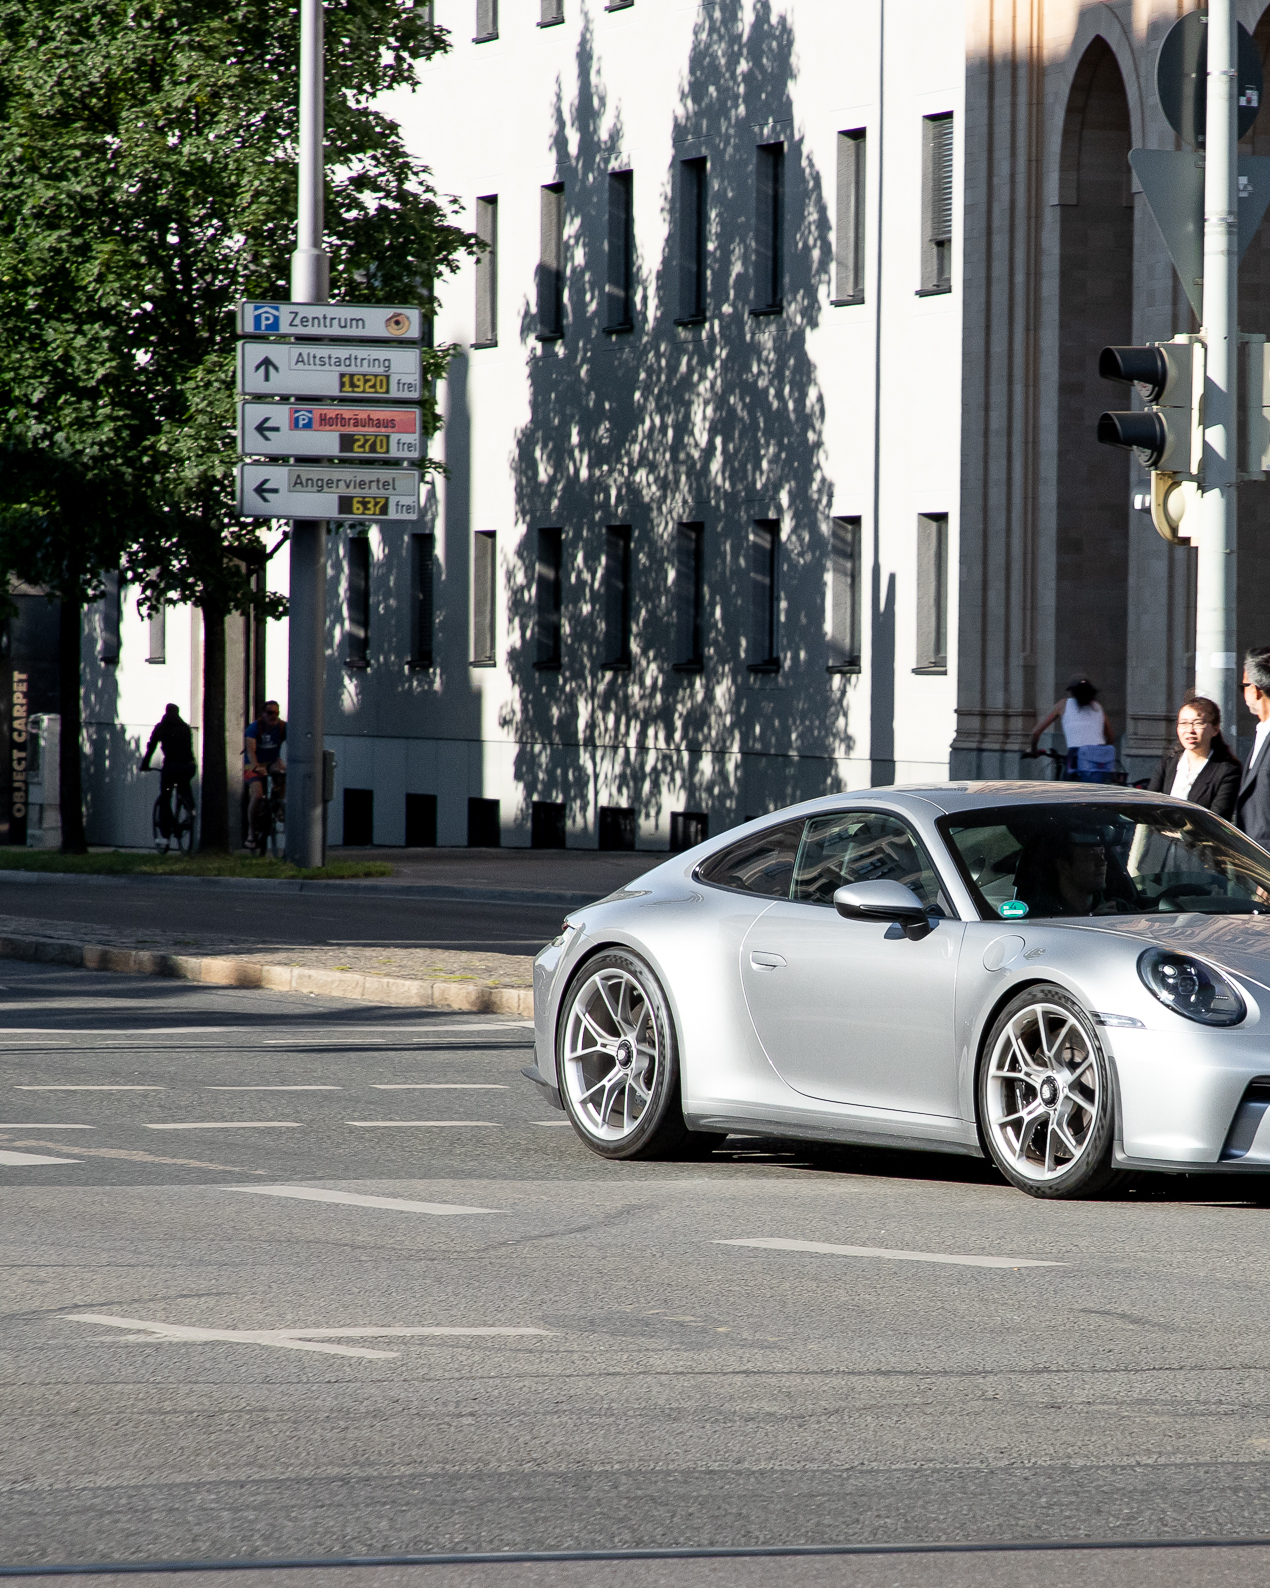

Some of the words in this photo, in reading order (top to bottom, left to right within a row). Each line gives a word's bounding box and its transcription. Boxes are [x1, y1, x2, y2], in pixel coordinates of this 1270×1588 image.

[288, 312, 366, 330] Zentrum
[294, 352, 391, 372] Altstadtring
[342, 375, 388, 393] 1920
[396, 378, 418, 392] frei
[318, 413, 396, 428] Hofbräuhaus
[353, 435, 388, 452] 270
[396, 438, 418, 452] frei
[292, 475, 396, 492] Angerviertel
[352, 497, 386, 514] 637
[396, 501, 416, 514] frei
[13, 671, 28, 742] CARPET
[12, 749, 26, 818] OBJECT
